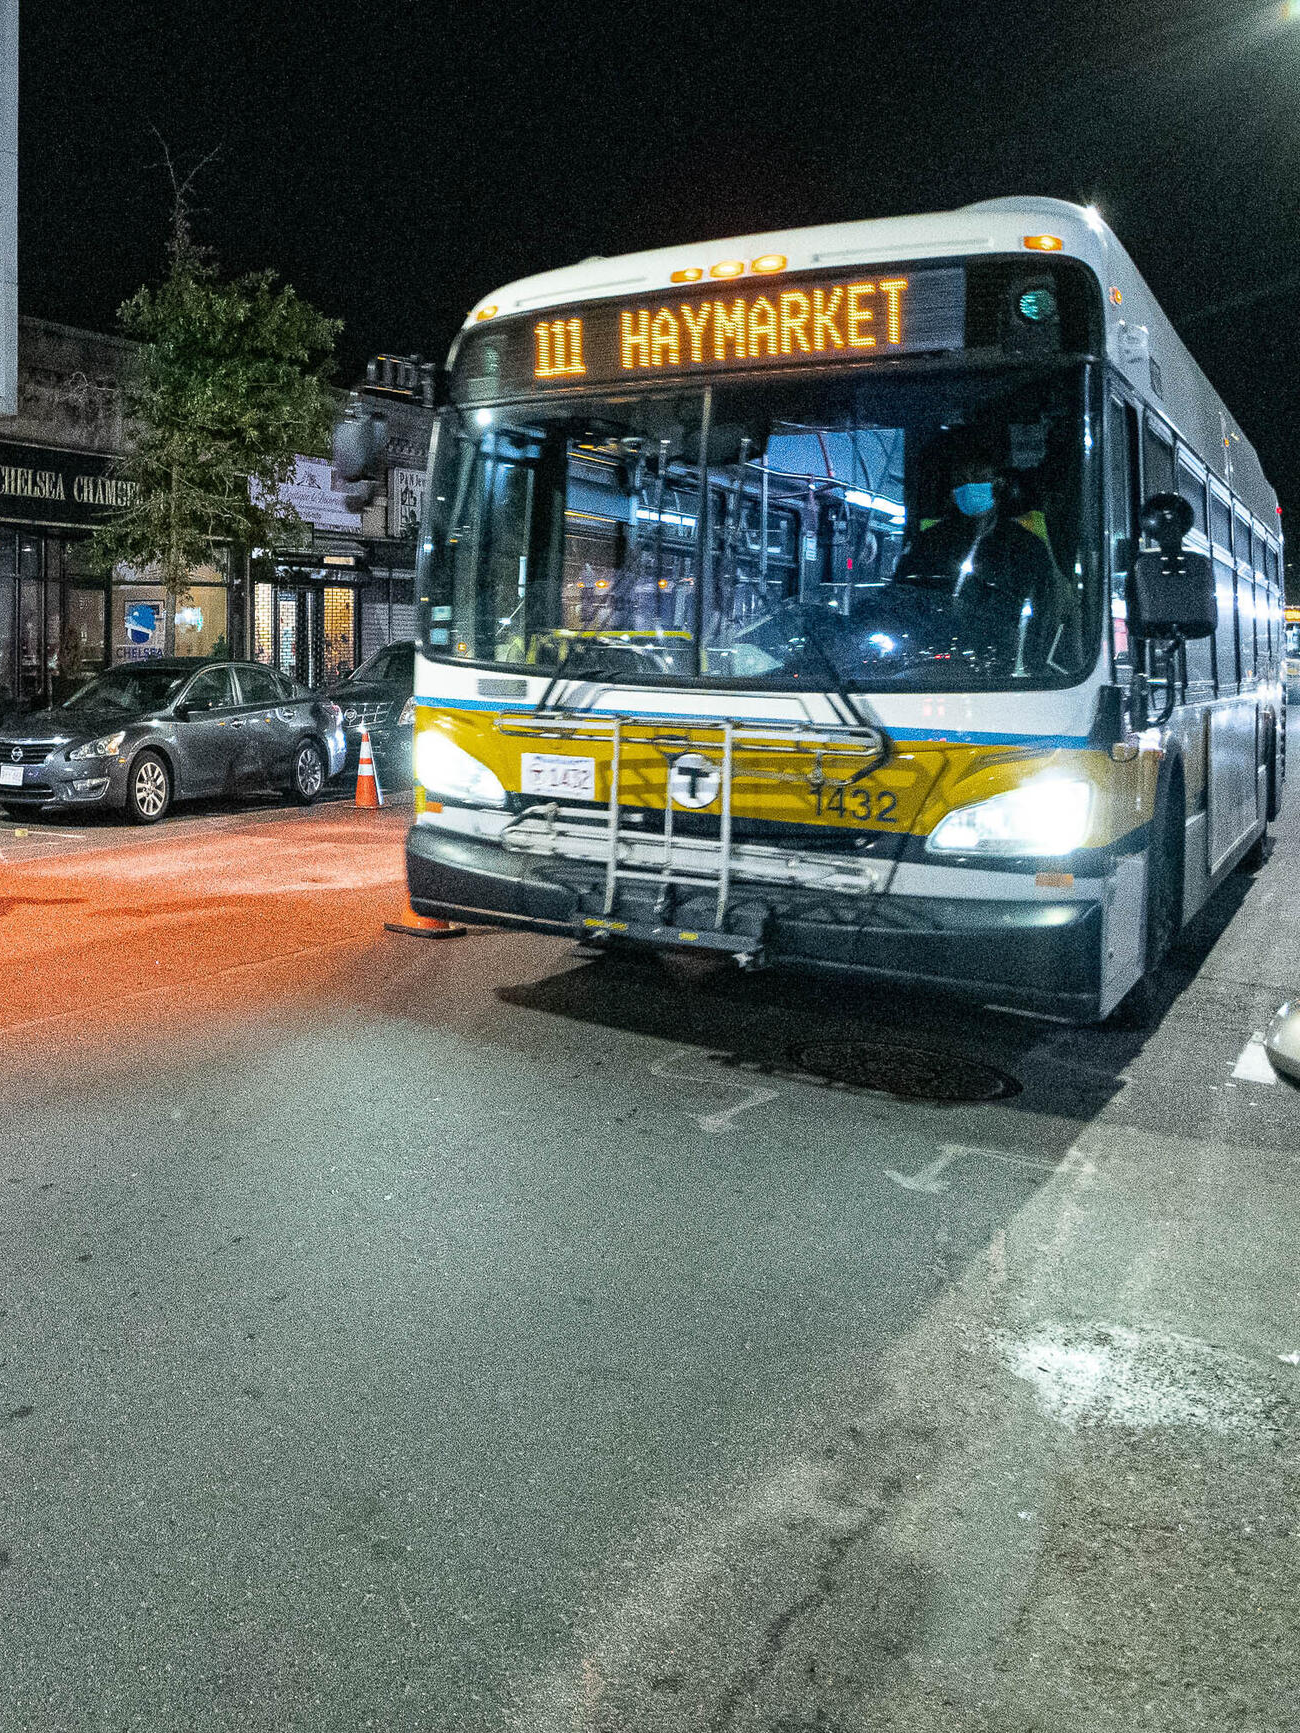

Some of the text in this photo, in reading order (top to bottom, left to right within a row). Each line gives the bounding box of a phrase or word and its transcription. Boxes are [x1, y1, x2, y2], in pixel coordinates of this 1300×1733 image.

[534, 277, 909, 379] 111 HAYMARKET
[116, 647, 164, 658] CHELSEA
[810, 784, 897, 823] 1432
